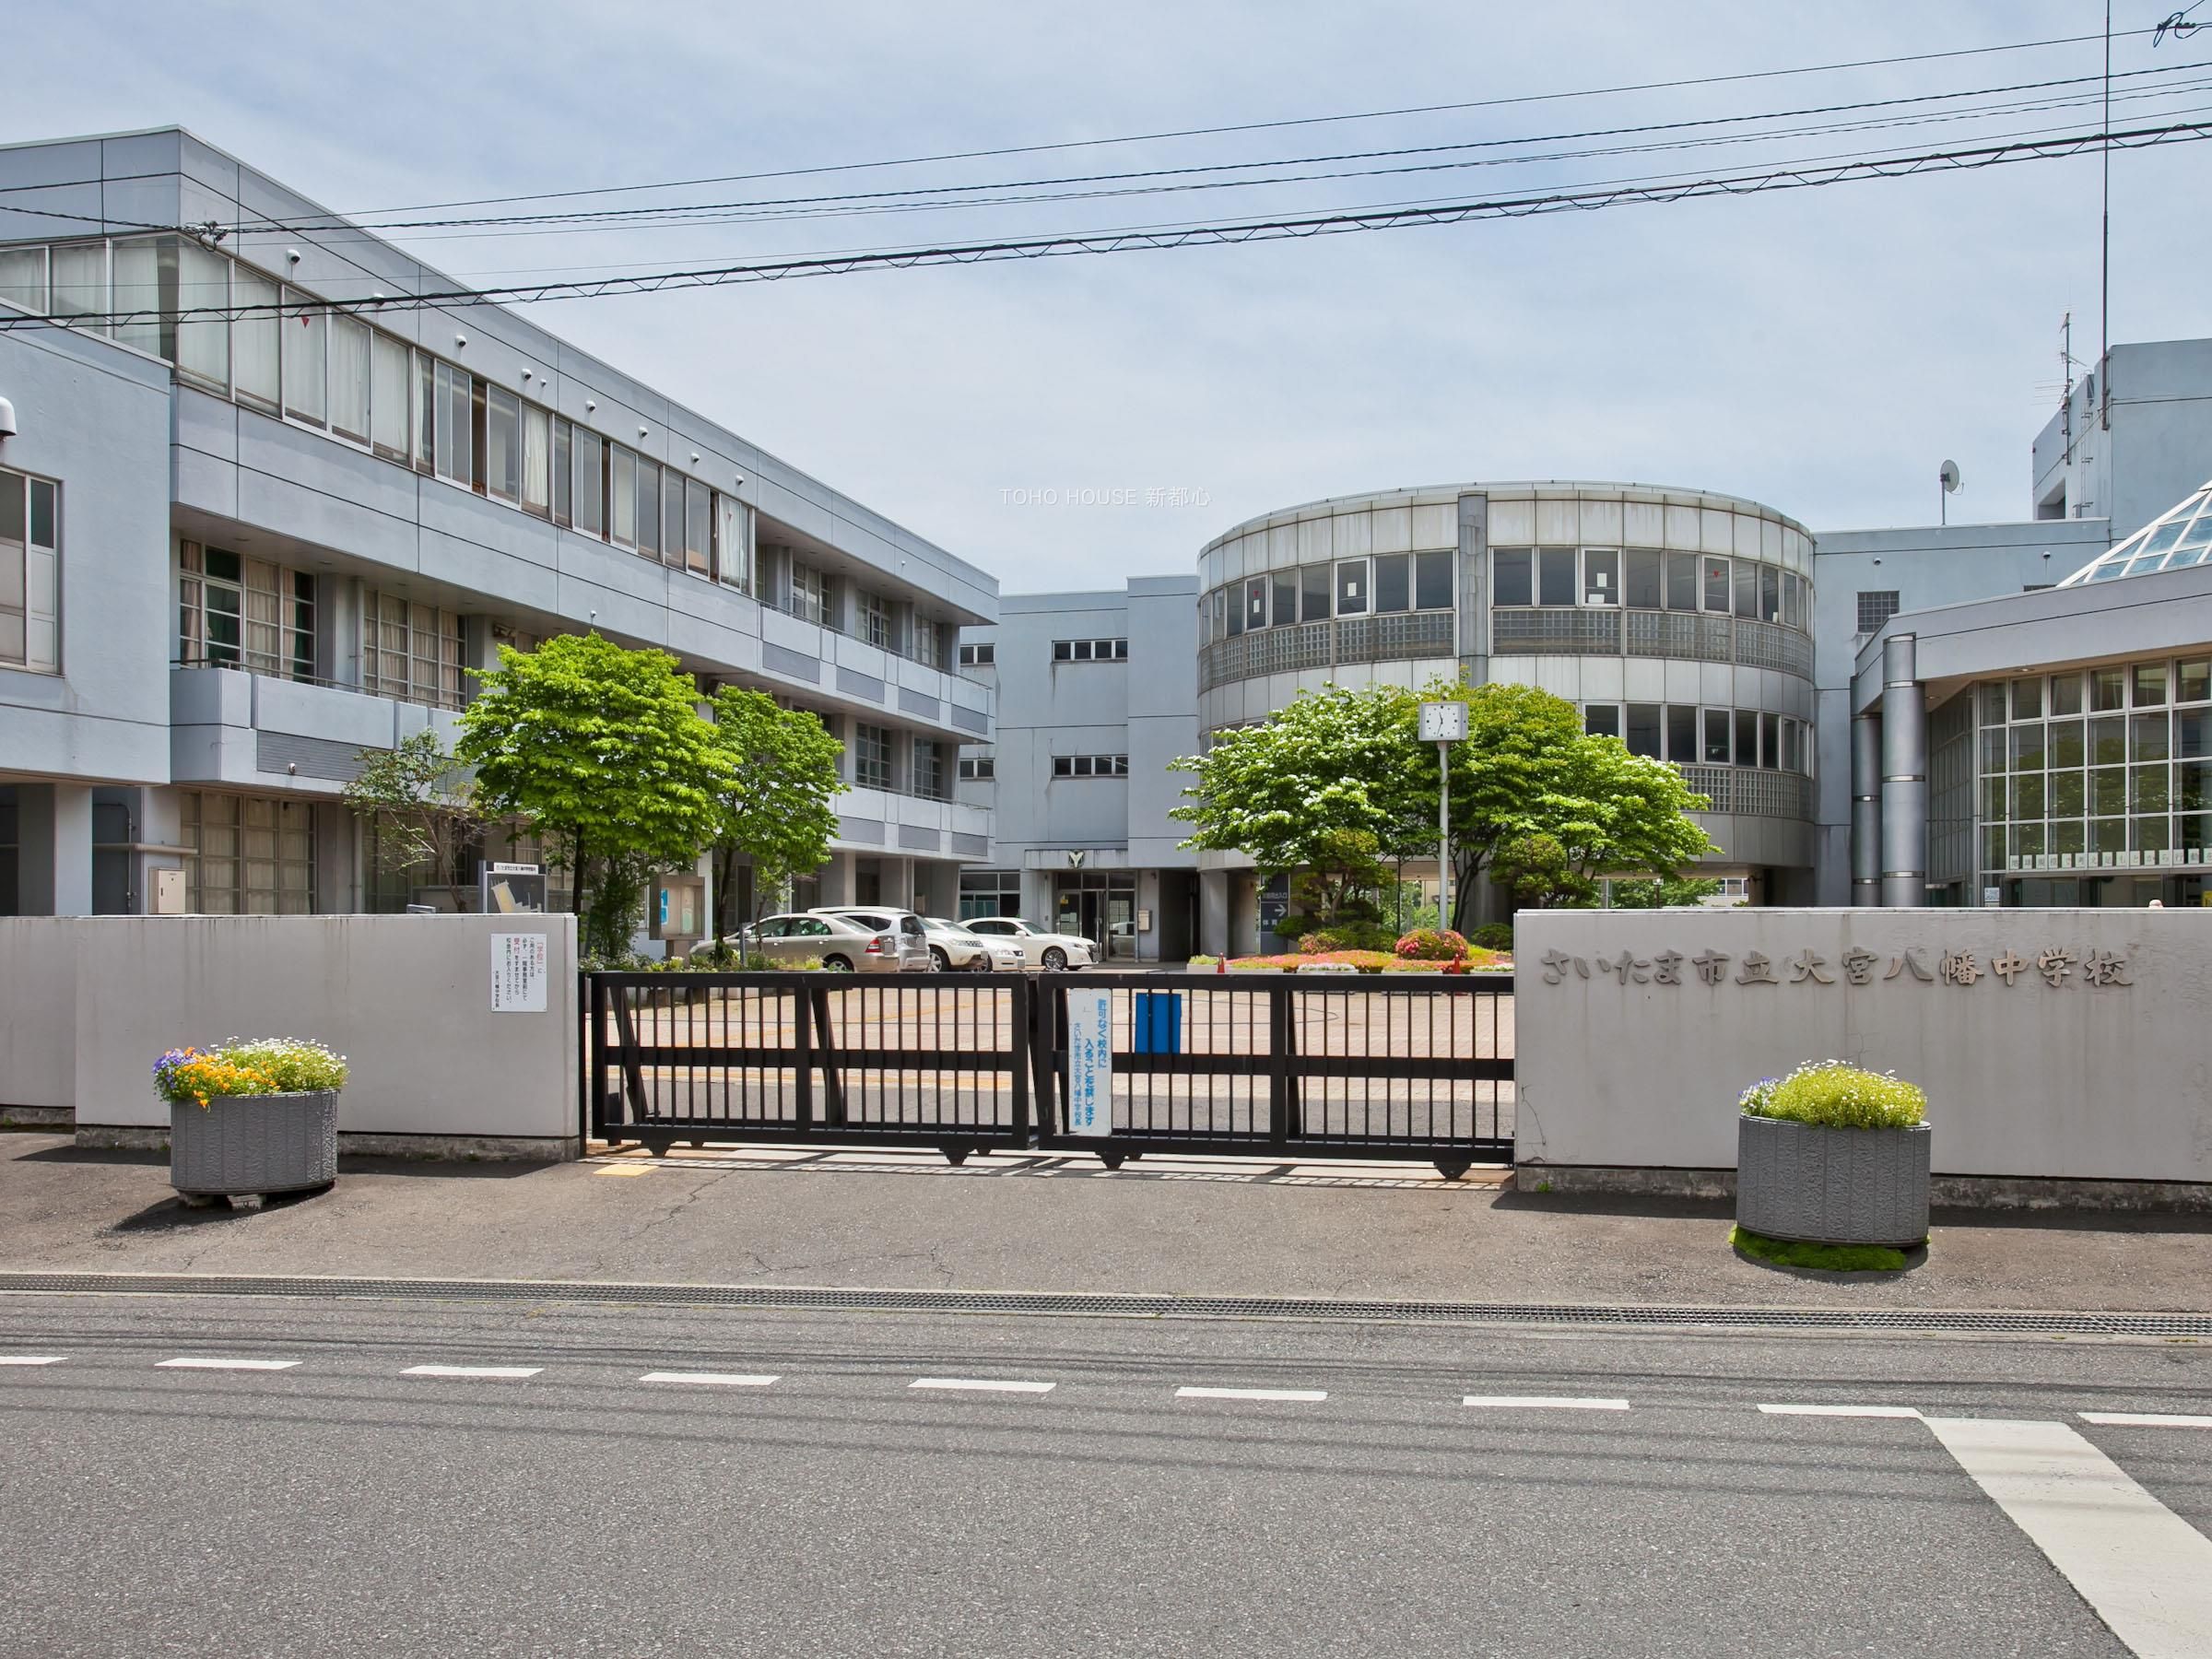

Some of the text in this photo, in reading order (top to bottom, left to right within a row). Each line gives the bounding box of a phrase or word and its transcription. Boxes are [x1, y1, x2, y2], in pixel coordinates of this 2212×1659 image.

[1540, 945, 2135, 988] さいたま市立大宮八幡中学校
[1098, 998, 1107, 1068] 許可なく校内に
